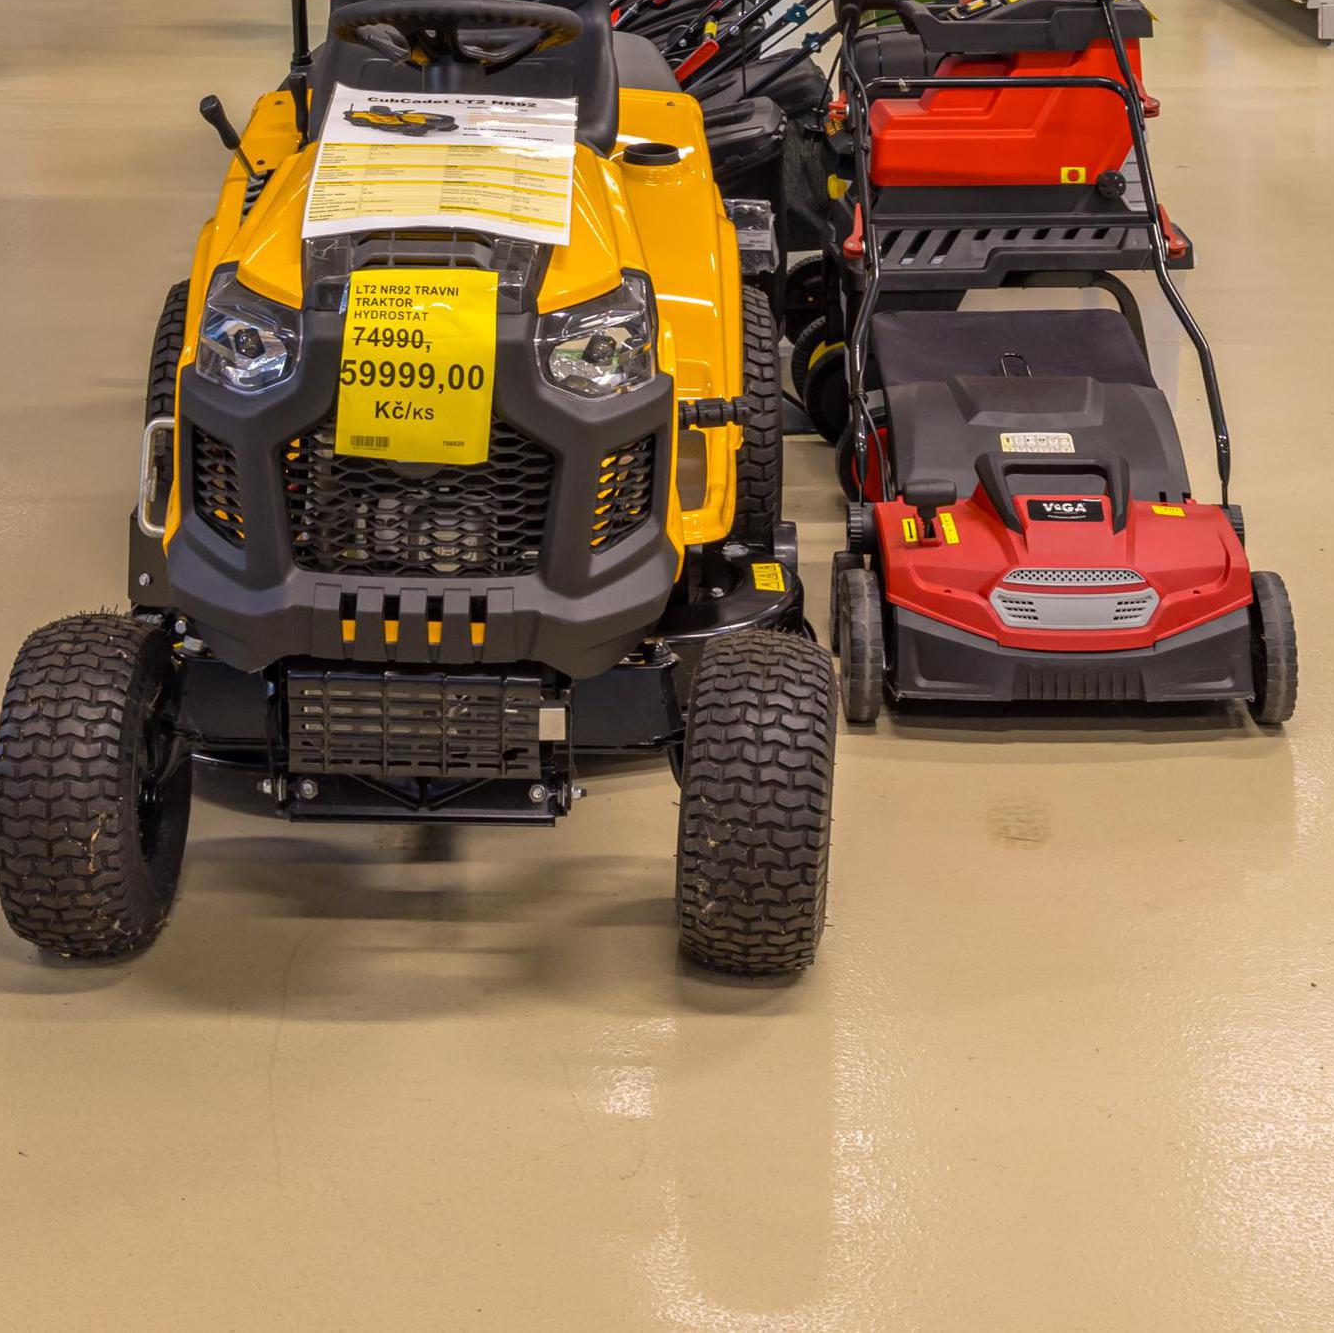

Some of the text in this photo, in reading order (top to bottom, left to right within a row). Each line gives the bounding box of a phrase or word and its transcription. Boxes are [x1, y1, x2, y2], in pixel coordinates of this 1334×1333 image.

[367, 96, 538, 109] CubCadet LT2 NR92
[356, 285, 459, 296] LT2 NR92 TRAVNI
[356, 297, 413, 307] TRAKTOR
[354, 311, 429, 321] HYDROSTAT
[353, 326, 432, 353] 74990,
[339, 359, 484, 395] 59999,00
